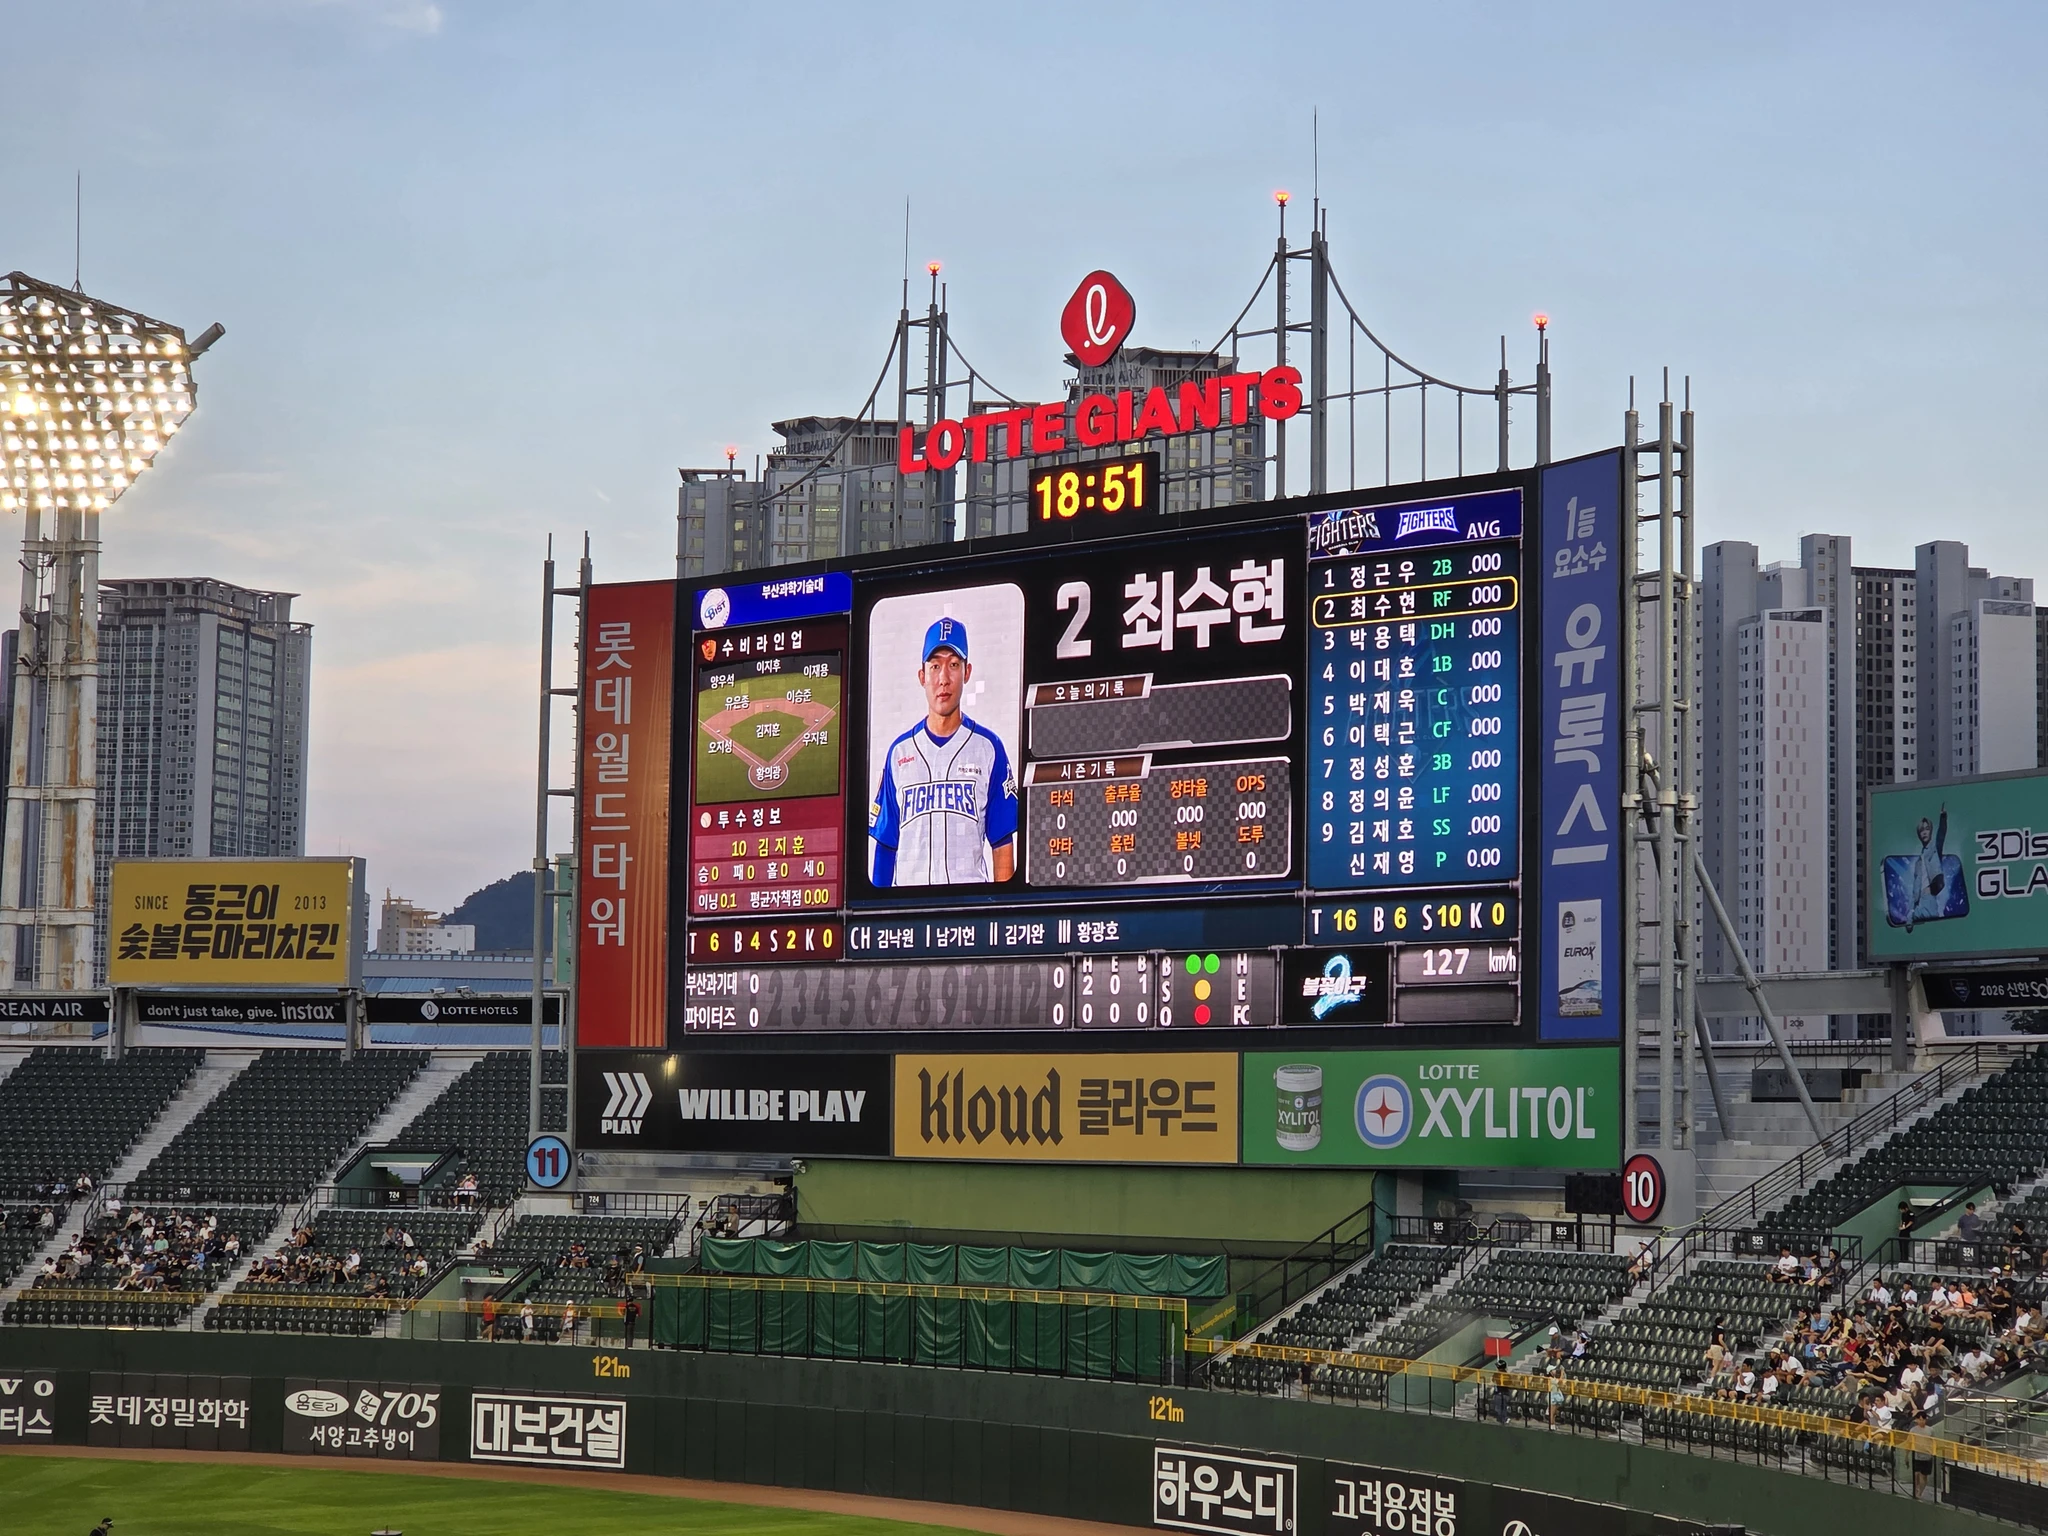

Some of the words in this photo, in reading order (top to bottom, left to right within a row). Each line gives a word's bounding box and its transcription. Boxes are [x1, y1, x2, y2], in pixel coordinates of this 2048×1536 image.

[900, 402, 1065, 475] LOTTE
[1076, 366, 1303, 447] GIANTS
[1036, 463, 1144, 520] 18:51
[1309, 512, 1381, 550] FIGHTERS
[1395, 507, 1459, 540] FIGHTERS
[1467, 520, 1500, 539] AVG
[1566, 496, 1596, 542] 1등
[1324, 569, 1335, 588] 1
[1433, 559, 1452, 576] 2B
[1468, 553, 1501, 575] .000
[1553, 541, 1606, 579] 요소수
[762, 578, 824, 599] 부산과학기술대
[1324, 600, 1335, 618] 2
[1433, 591, 1452, 608] RF
[1468, 585, 1501, 607] .000
[1056, 581, 1092, 659] 2
[1122, 558, 1286, 652] 최수현
[1324, 631, 1335, 650] 3
[1431, 623, 1454, 640] DH
[1468, 617, 1501, 639] .000
[756, 659, 781, 674] 이지후
[1323, 663, 1334, 682] 4
[1432, 656, 1452, 672] 1B
[1468, 650, 1501, 671] .000
[710, 673, 735, 689] 양우석
[1324, 696, 1334, 715] 5
[1437, 689, 1448, 705] C
[1468, 684, 1501, 705] .000
[756, 723, 781, 738] 김지훈
[802, 731, 828, 746] 우지원
[1323, 727, 1334, 747] 6
[1433, 721, 1452, 738] CF
[1468, 717, 1501, 738] .000
[1552, 602, 1608, 866] 유록스
[708, 740, 733, 754] 오지성
[1323, 759, 1334, 778] 7
[1432, 754, 1452, 771] 3B
[1468, 749, 1501, 770] .000
[588, 622, 635, 946] 롯데월드타워
[1050, 789, 1074, 807] 타석
[1105, 784, 1141, 804] 출루율
[1170, 779, 1208, 799] 장타율
[1236, 775, 1265, 792] OPS
[1322, 791, 1334, 811] 8
[1433, 787, 1450, 804] LF
[1468, 783, 1501, 804] .000
[902, 782, 976, 824] FIGHTERS
[1108, 810, 1137, 829] .000
[1174, 805, 1203, 825] .000
[1235, 801, 1266, 821] .000
[1049, 837, 1073, 856] 안타
[1110, 833, 1135, 853] 홈런
[1176, 830, 1201, 850] 볼넷
[1238, 825, 1264, 844] 도루
[1322, 823, 1333, 842] 9
[1433, 819, 1450, 836] SS
[1468, 815, 1501, 835] .000
[732, 841, 747, 857] 10
[1436, 852, 1447, 868] P
[1467, 848, 1501, 868] 0.00
[135, 895, 168, 910] SINCE
[184, 885, 280, 921] 동근이
[294, 895, 326, 910] 2013
[699, 893, 718, 910] 이닝
[720, 893, 737, 908] 0.1
[750, 889, 801, 908] 평균자책점
[804, 888, 829, 905] 0.00
[1312, 909, 1322, 935] T
[1334, 909, 1357, 931] 16
[1374, 907, 1385, 932] B
[1394, 907, 1407, 929] 6
[1422, 904, 1433, 931] S
[1438, 904, 1462, 927] 10
[1470, 902, 1482, 929] K
[1492, 902, 1505, 926] 0
[117, 923, 340, 960] 숯불두마리치킨
[851, 926, 871, 950] CH
[1077, 921, 1120, 944] 황광호
[1423, 948, 1470, 975] 127
[1489, 947, 1516, 973] km/h
[1564, 946, 1596, 960] EUROX
[686, 972, 737, 996] 부산과기대
[1302, 976, 1367, 997] 불꽃야구
[1980, 985, 2005, 996] 2026
[2007, 982, 2031, 998] 신한
[52, 1002, 84, 1016] AIR
[147, 1004, 180, 1017] don't
[183, 1005, 208, 1020] just
[211, 1006, 243, 1020] take,
[247, 1006, 277, 1020] give.
[282, 1002, 334, 1020] instax
[442, 1006, 477, 1016] LOTTE
[480, 1006, 519, 1016] HOTELS
[685, 1006, 736, 1030] 파이터즈
[1419, 1064, 1479, 1080] LOTTE
[678, 1089, 784, 1121] WILLBE
[789, 1090, 867, 1122] PLAY
[917, 1067, 1064, 1146] Kloud
[1077, 1078, 1218, 1136] 클라우드
[1278, 1110, 1320, 1126] XYLITOL
[1418, 1086, 1596, 1140] XYLITOL
[601, 1119, 643, 1134] PLAY
[534, 1148, 560, 1177] 11
[1627, 1171, 1654, 1208] 10
[1433, 1222, 1444, 1231] 925
[1556, 1226, 1567, 1236] 925
[1752, 1235, 1763, 1245] 925
[1963, 1247, 1974, 1257] 924
[592, 1355, 630, 1378] 121m
[89, 1396, 249, 1429] 롯데정밀화학
[296, 1393, 338, 1412] 움트리
[380, 1391, 440, 1428] 705
[1149, 1396, 1184, 1423] 121m
[310, 1425, 414, 1451] 서양고추냉이
[476, 1403, 620, 1459] 대보건설
[1158, 1461, 1284, 1531] 하우스디
[1332, 1479, 1457, 1536] 고려용접봉
